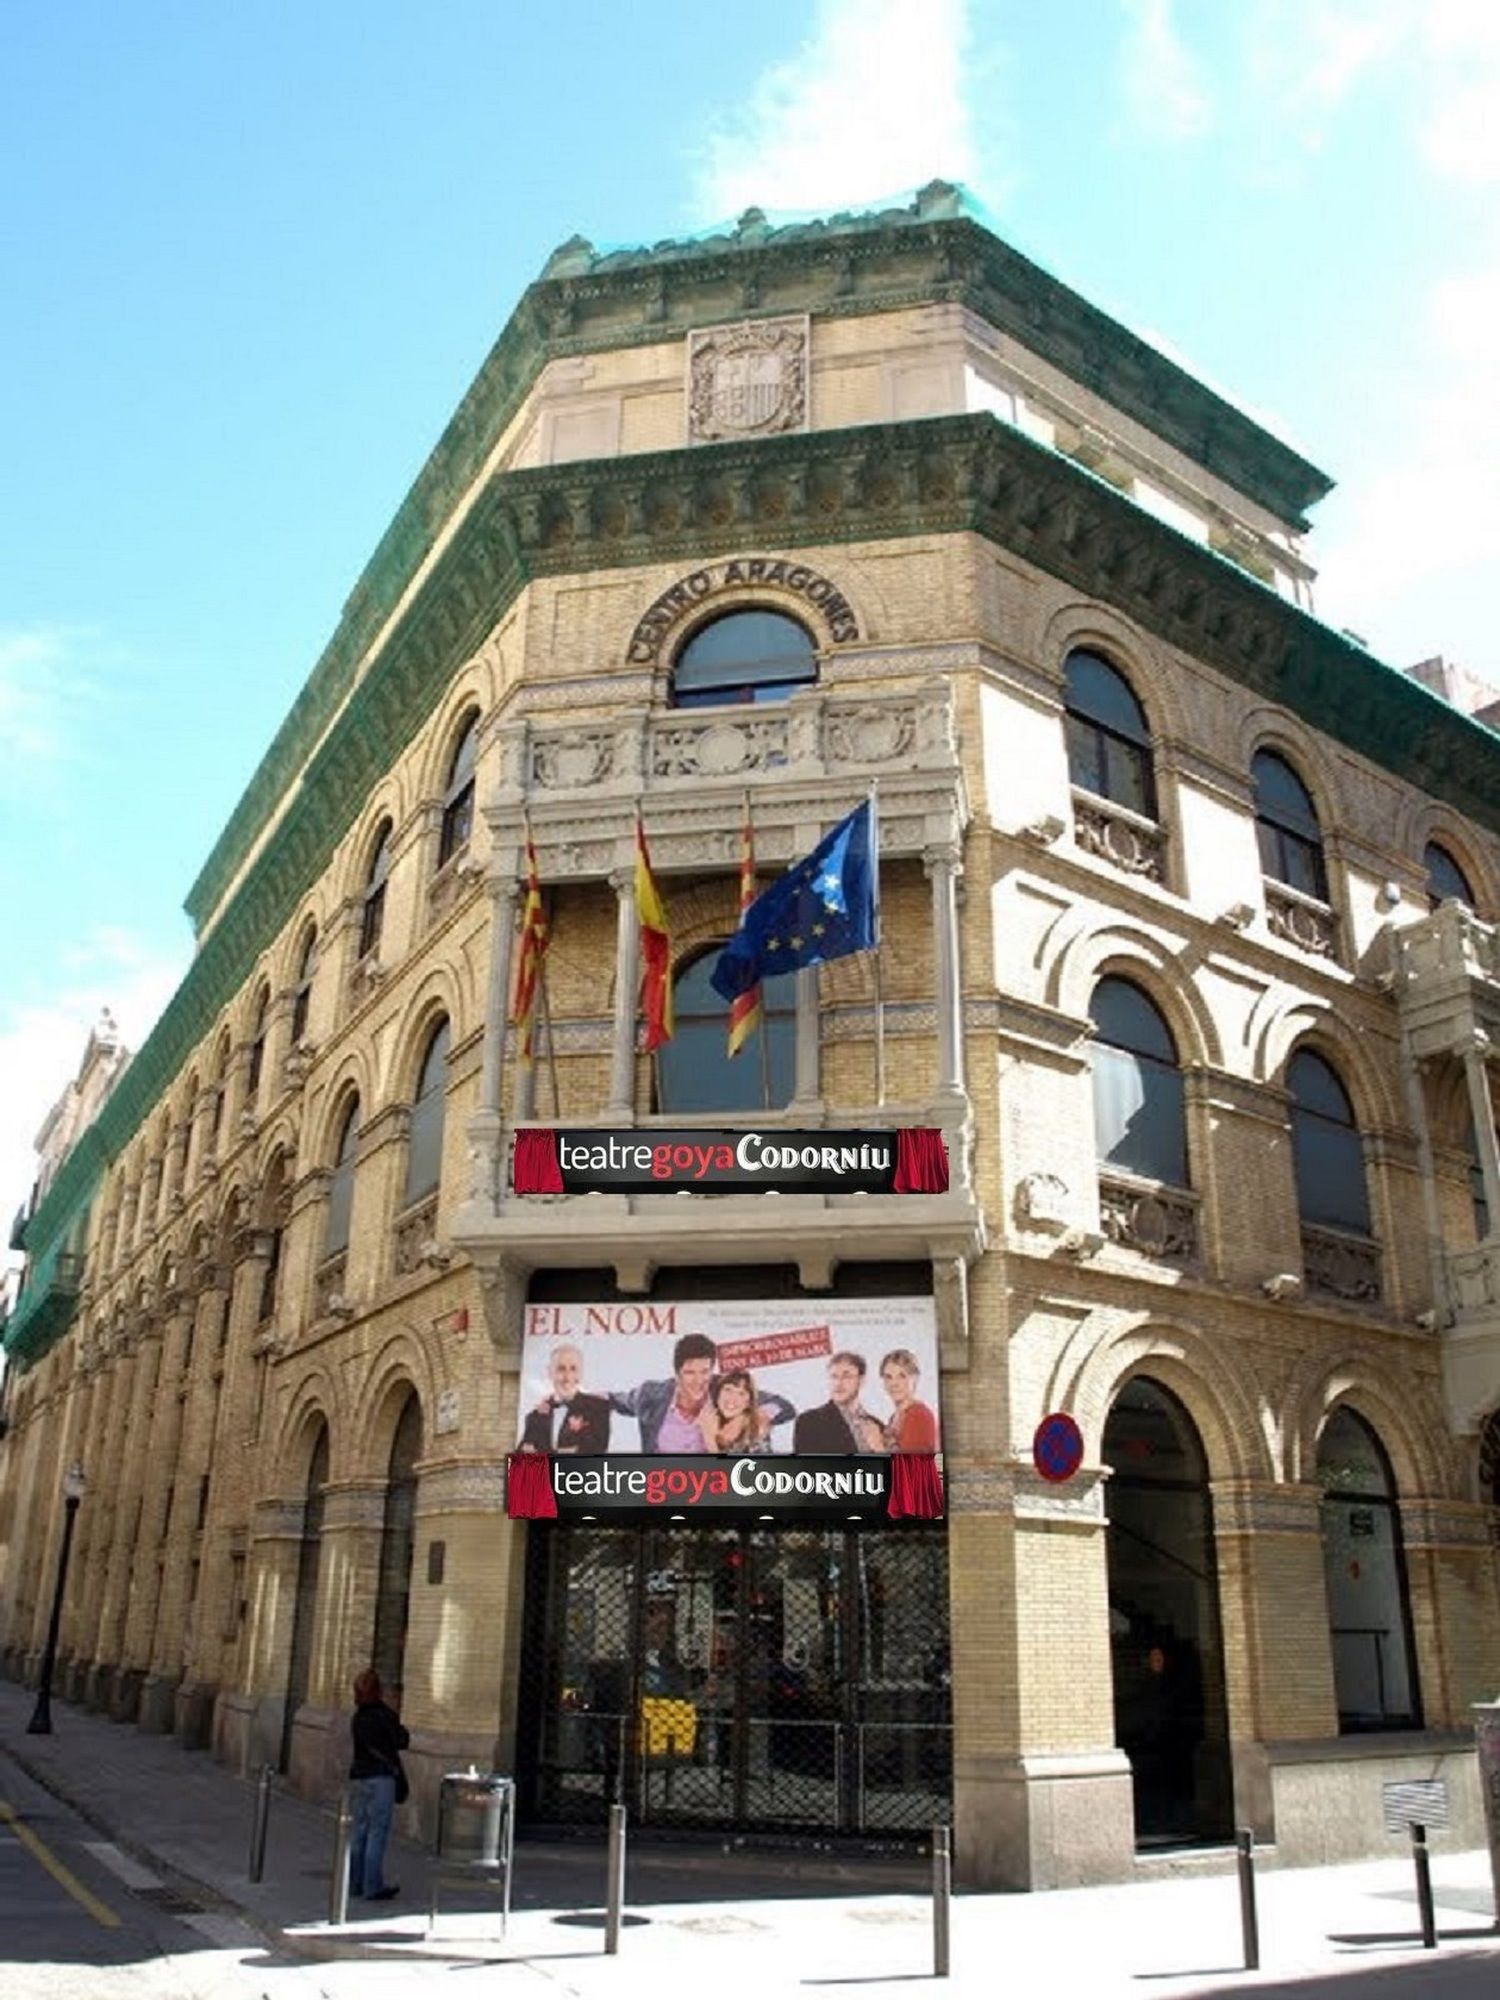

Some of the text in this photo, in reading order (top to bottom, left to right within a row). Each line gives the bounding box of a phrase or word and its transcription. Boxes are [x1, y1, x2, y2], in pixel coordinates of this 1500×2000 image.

[626, 570, 711, 663] CENTRO
[528, 1306, 571, 1336] EL
[584, 1305, 678, 1335] NOM
